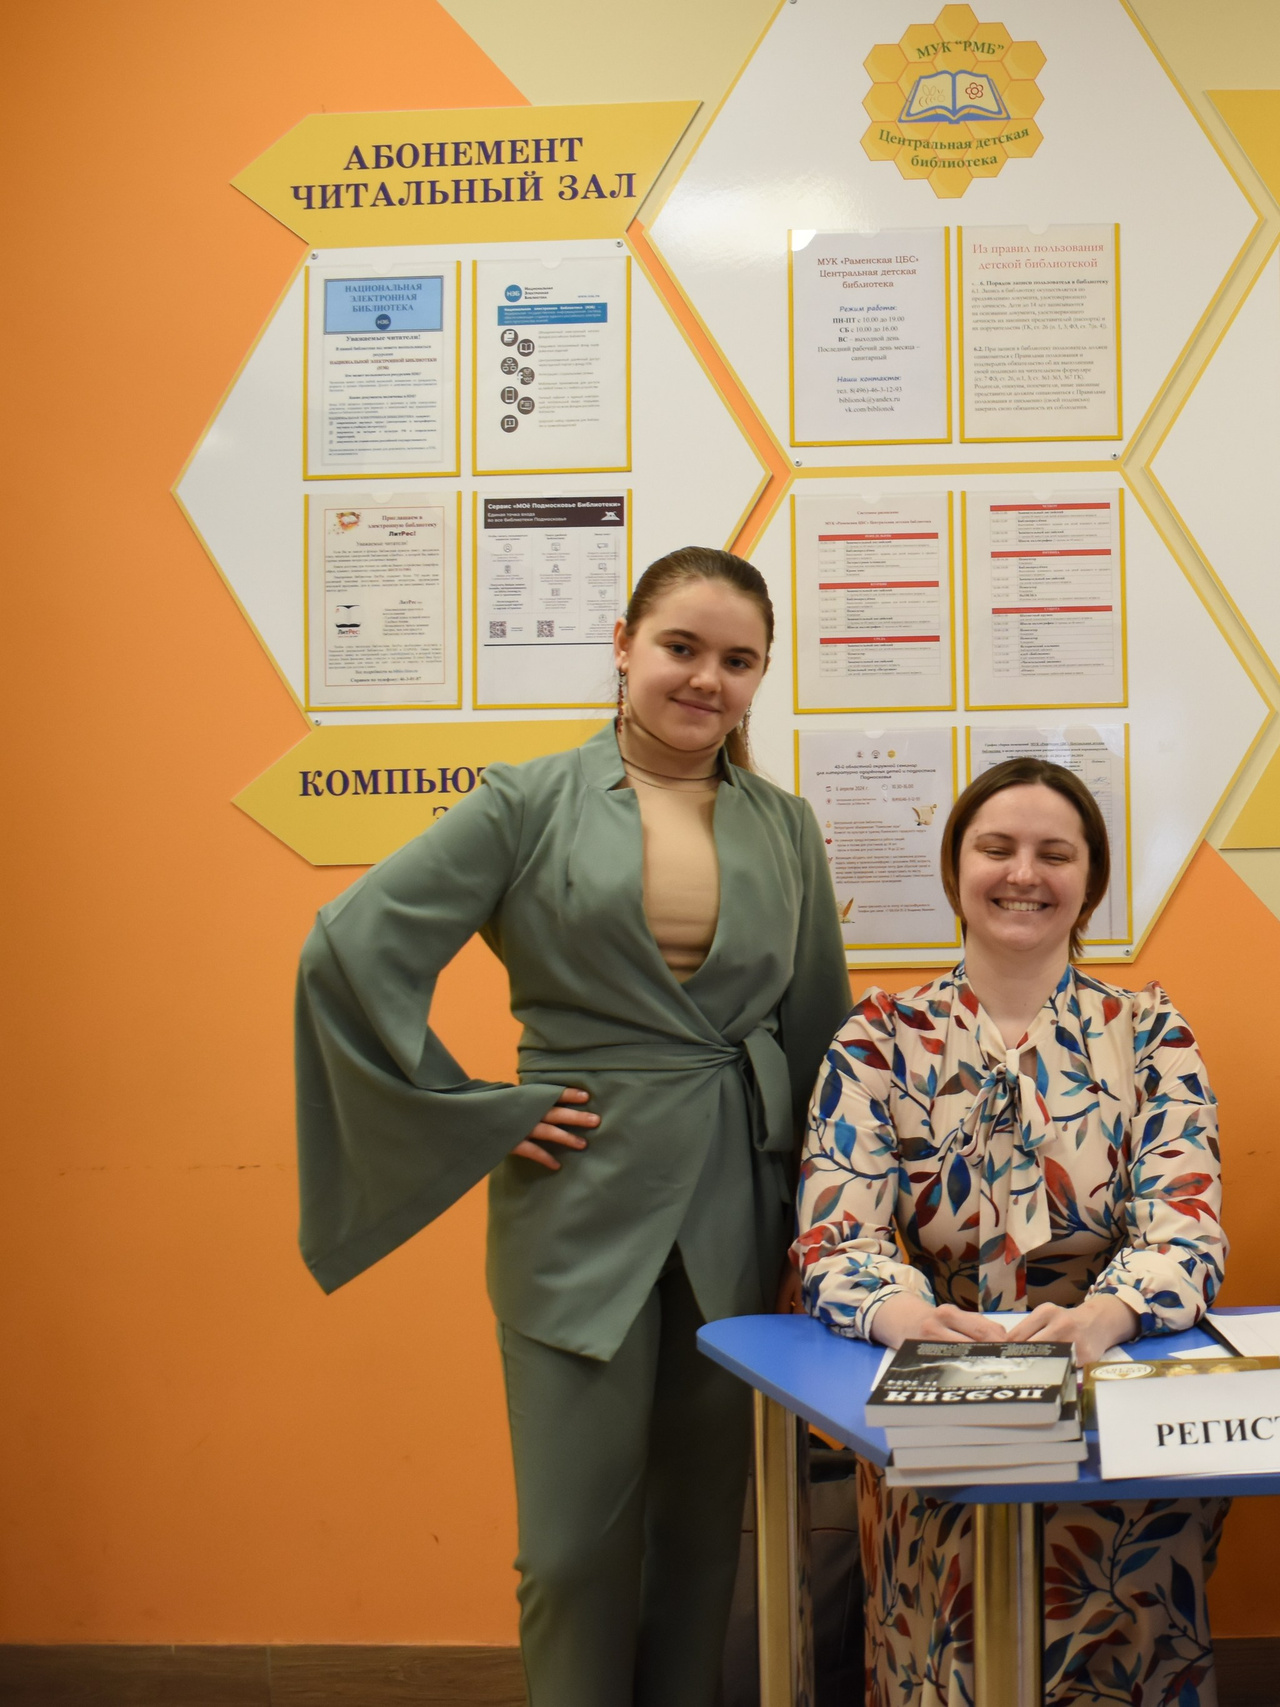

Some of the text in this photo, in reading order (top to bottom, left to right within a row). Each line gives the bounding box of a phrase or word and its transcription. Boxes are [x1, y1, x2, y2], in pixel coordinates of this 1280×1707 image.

[916, 40, 951, 59] МУК
[878, 128, 1030, 151] Центральная детская
[343, 137, 584, 171] АБОНЕМЕНТ
[910, 155, 998, 169] библиотека
[290, 170, 637, 211] ЧИТАЛЬНЫЙ ЗАЛ
[973, 243, 1104, 256] Из правил пользования
[817, 255, 919, 266] МУК «Раменская ЦБС»
[978, 259, 1021, 270] детской
[819, 268, 917, 278] Центральная детская
[345, 283, 422, 293] НАЦИОНАЛЬНАЯ
[842, 280, 894, 289] библиотека
[351, 293, 417, 302] ЭЛЕКТРОННАЯ
[352, 303, 414, 312] БИБЛИОТЕКА
[488, 503, 511, 511] Сервис
